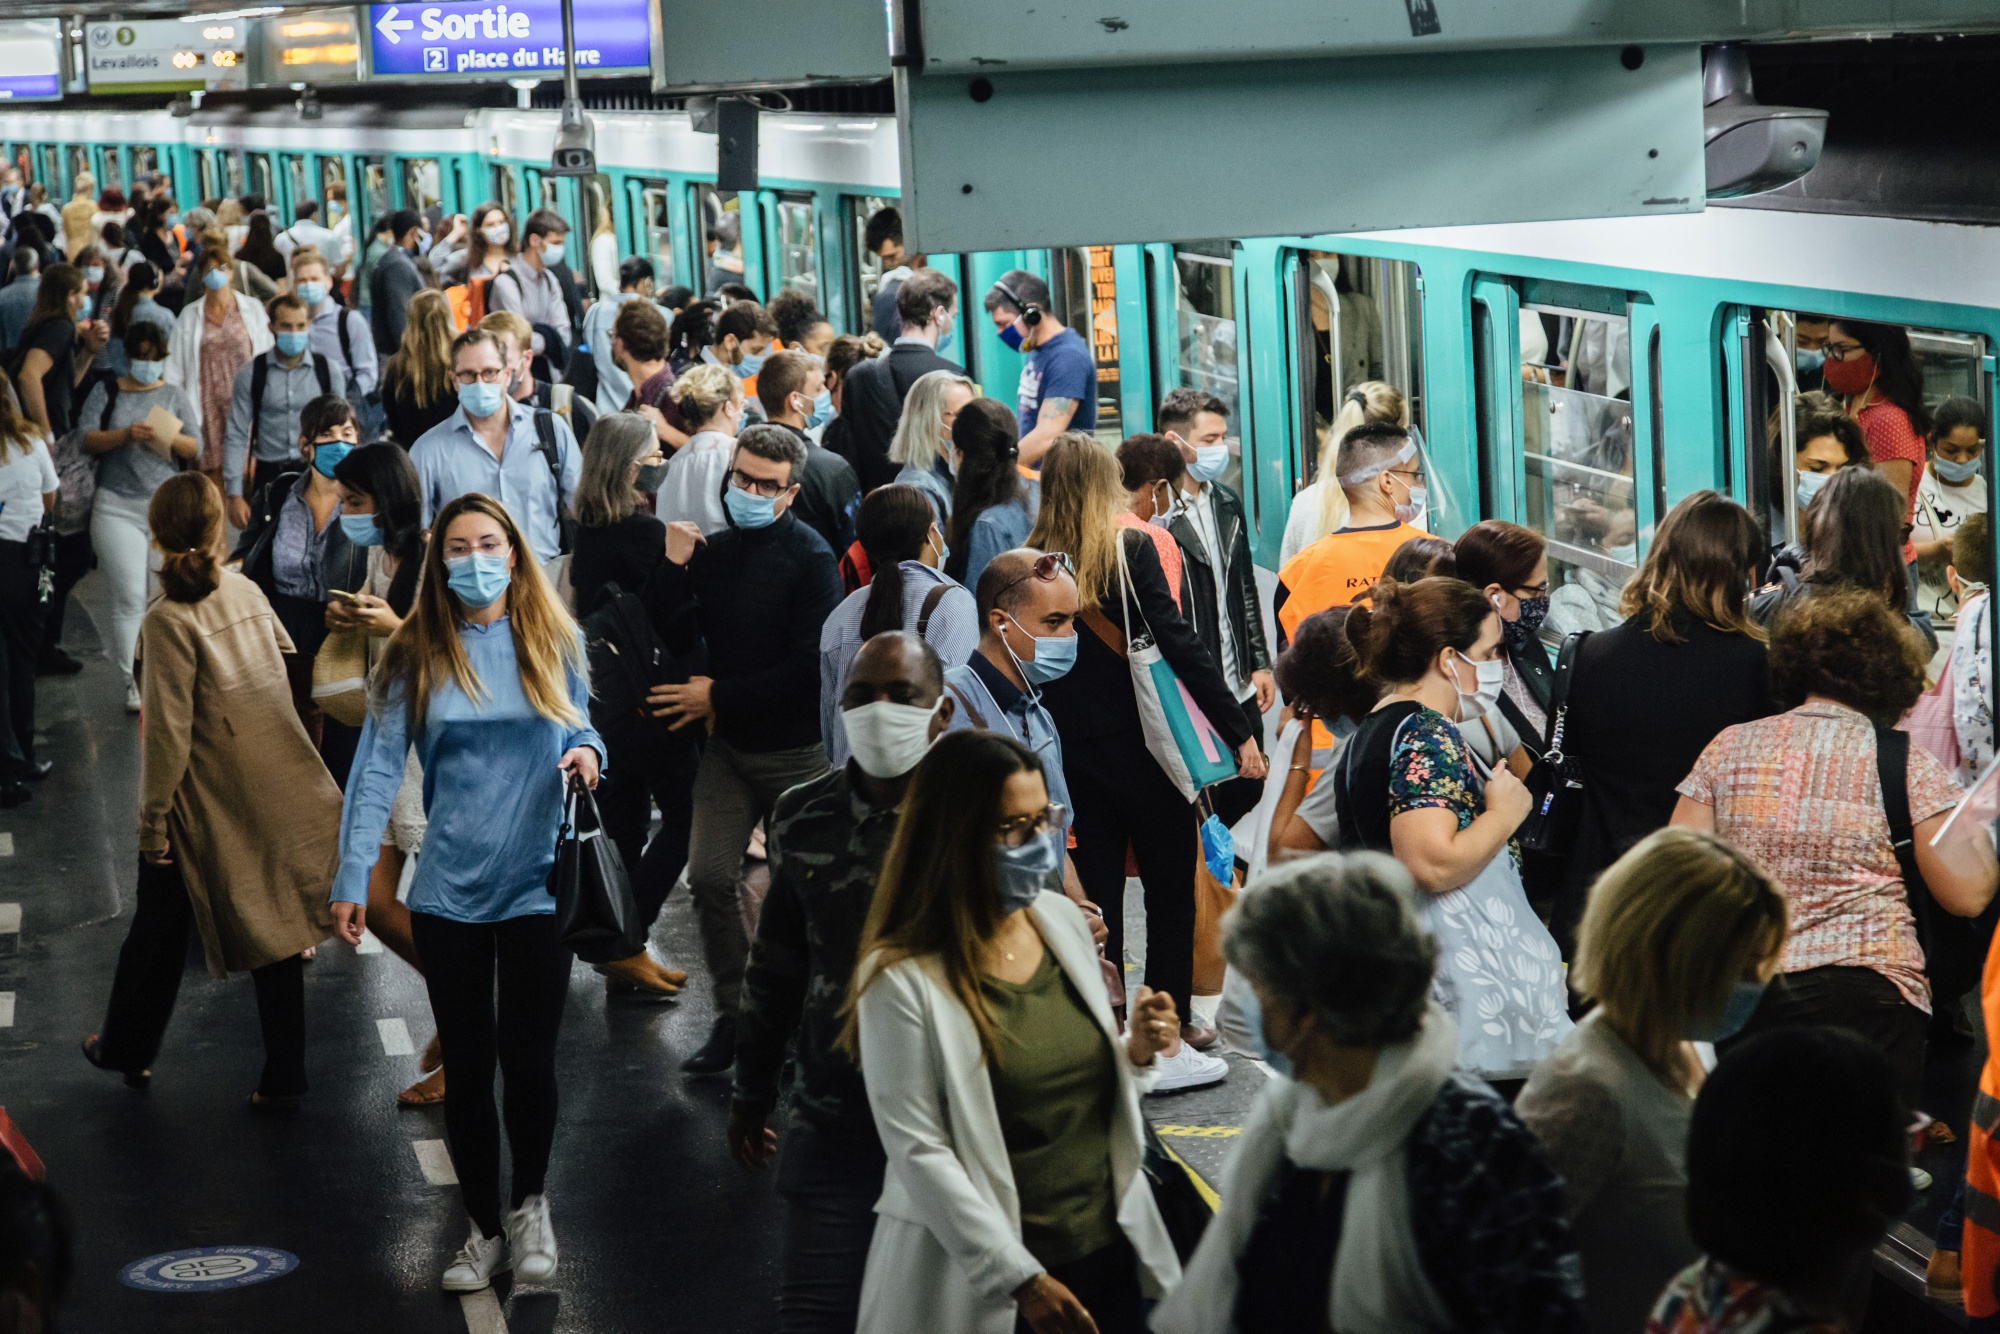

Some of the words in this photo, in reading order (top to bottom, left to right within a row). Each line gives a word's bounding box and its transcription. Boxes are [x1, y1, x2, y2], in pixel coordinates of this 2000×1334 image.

[421, 5, 530, 40] Sortie
[92, 54, 159, 70] Levallois
[212, 50, 236, 67] 02
[429, 50, 444, 69] 2
[456, 49, 509, 73] place
[512, 47, 539, 67] du
